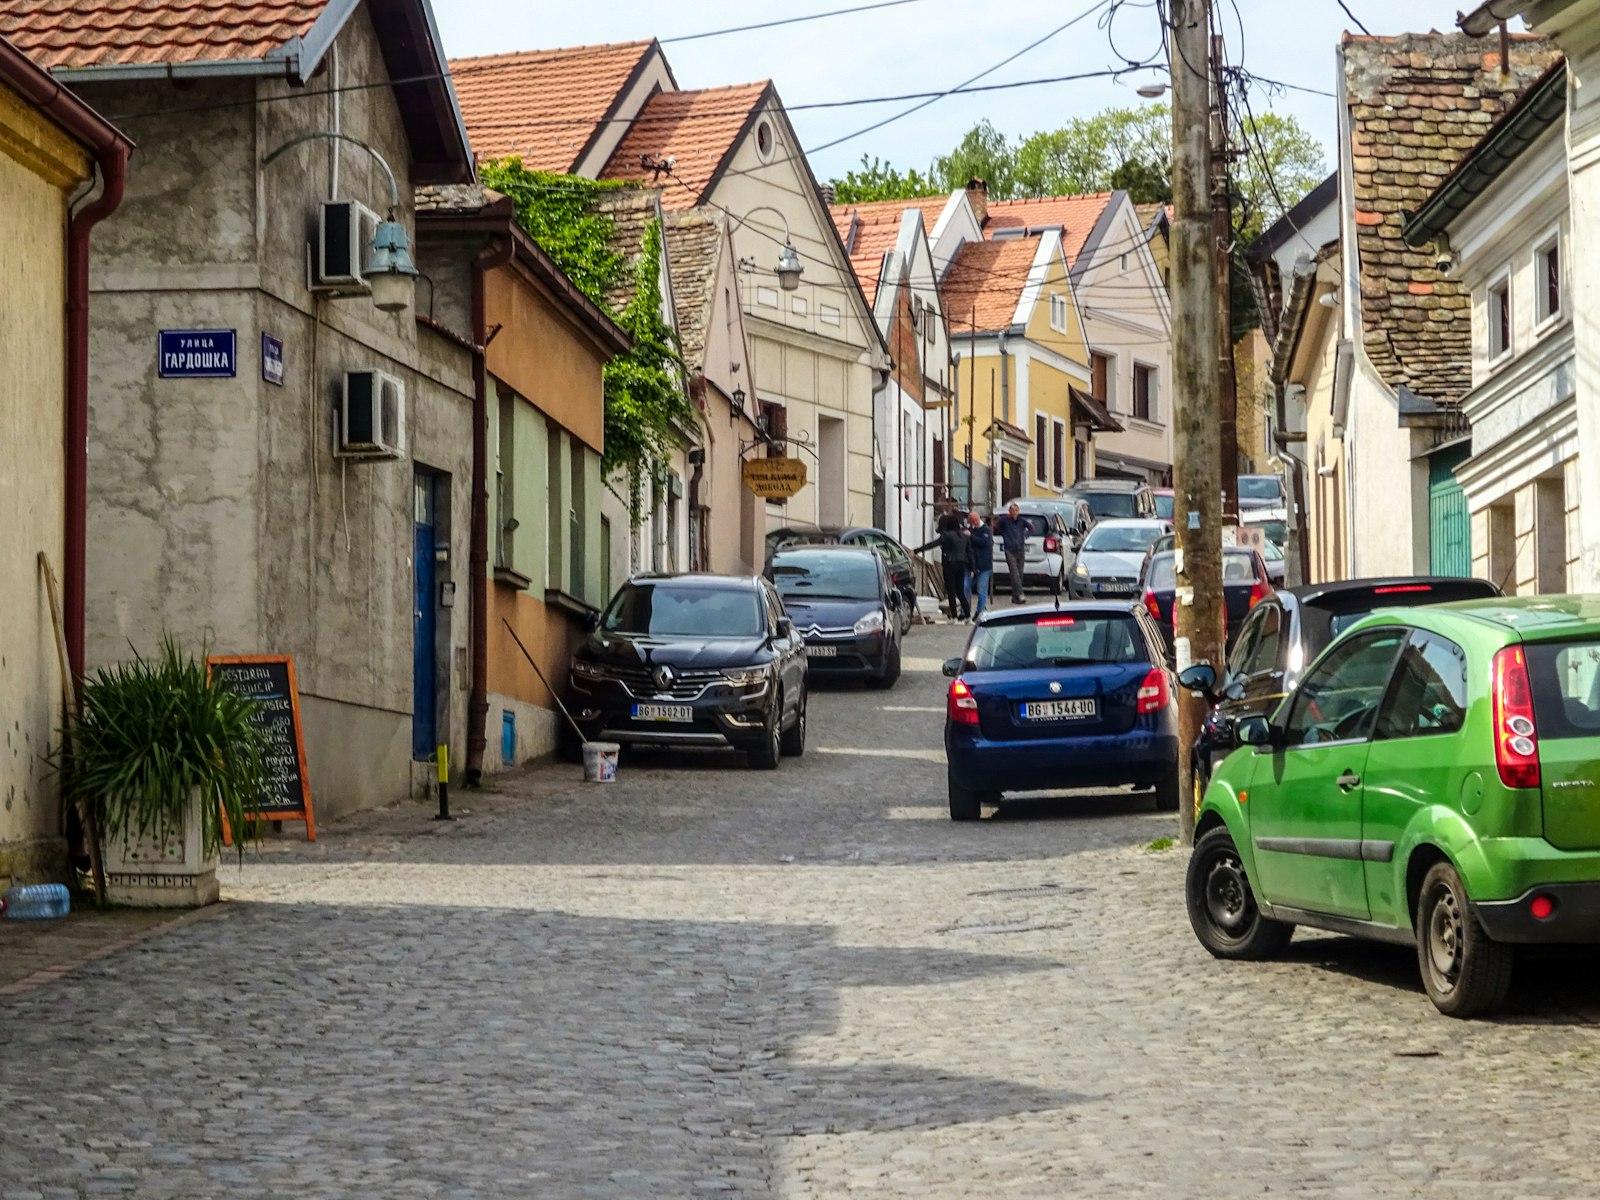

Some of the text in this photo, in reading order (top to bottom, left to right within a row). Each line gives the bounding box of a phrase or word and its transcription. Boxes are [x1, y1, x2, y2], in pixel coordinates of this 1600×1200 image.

[180, 338, 214, 348] УЛИЦА
[164, 351, 229, 370] ГАРДОШКА
[1028, 704, 1042, 717] BG
